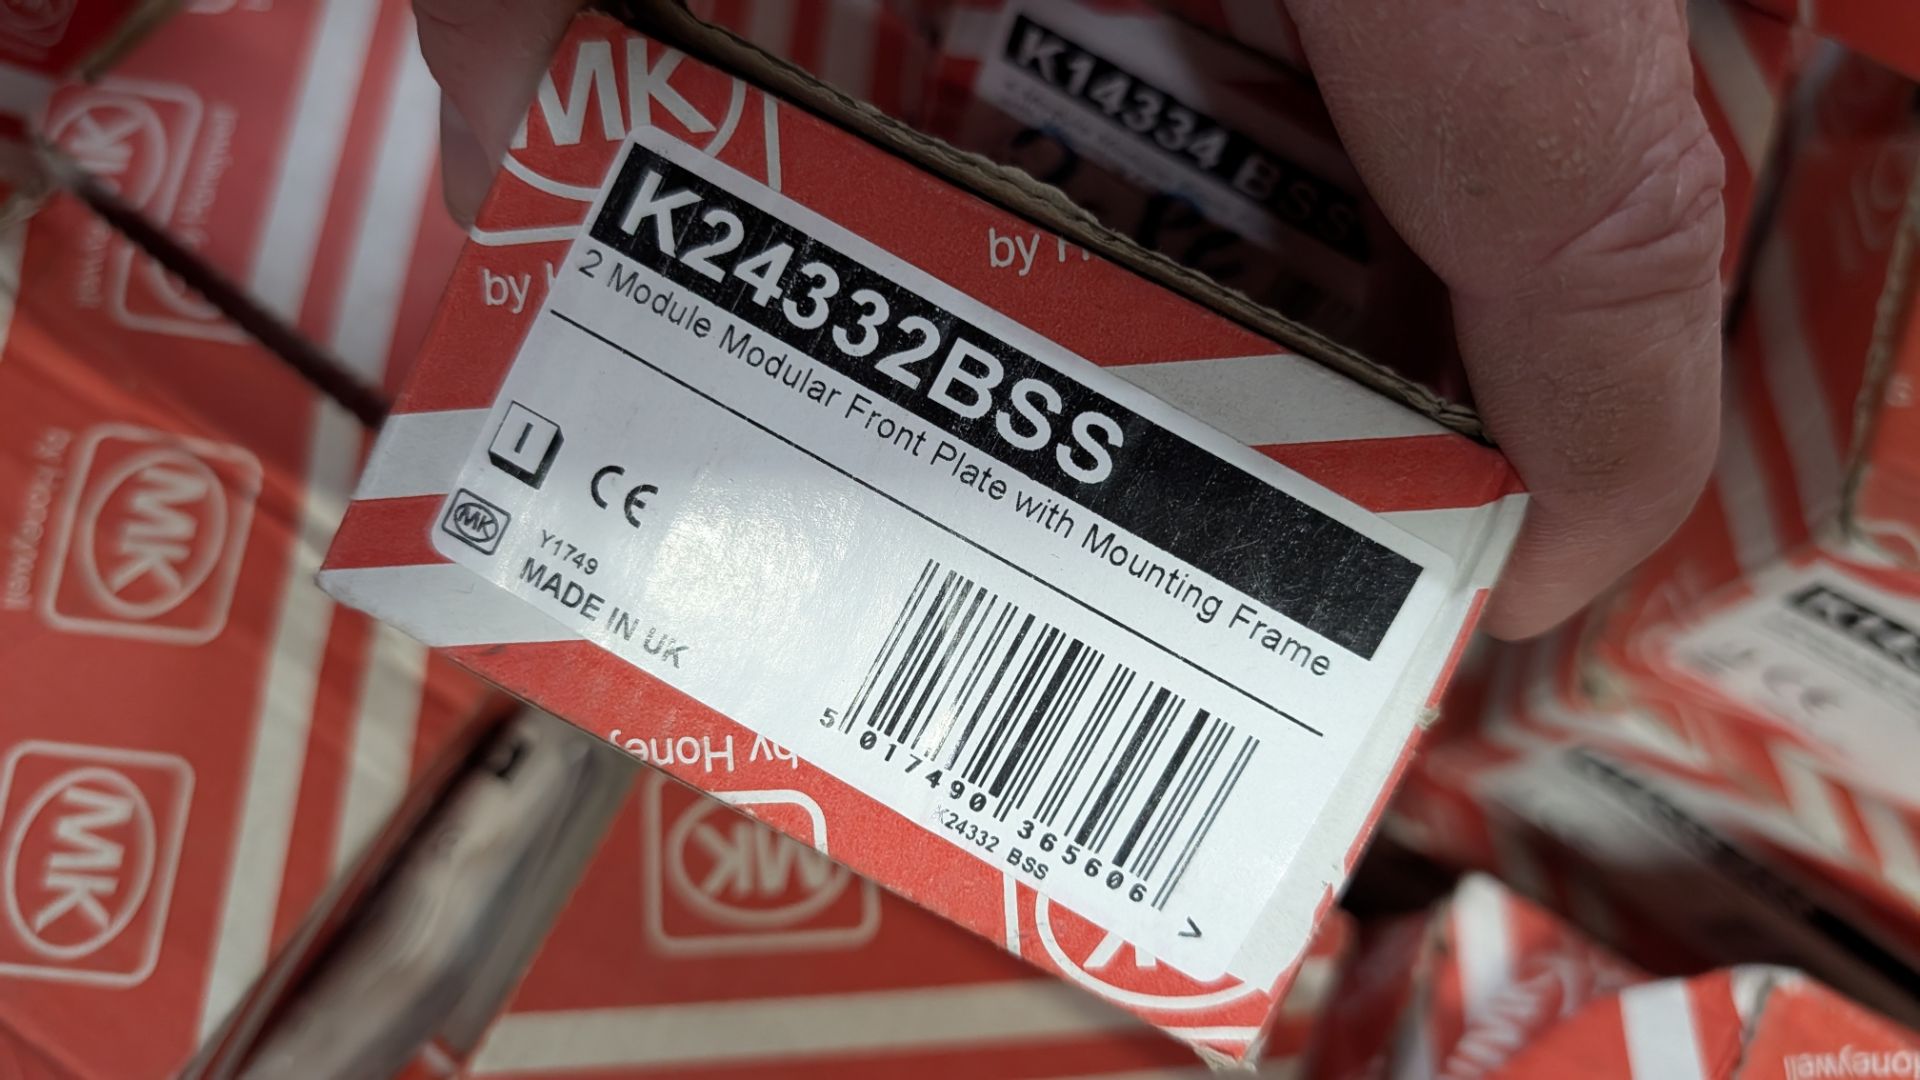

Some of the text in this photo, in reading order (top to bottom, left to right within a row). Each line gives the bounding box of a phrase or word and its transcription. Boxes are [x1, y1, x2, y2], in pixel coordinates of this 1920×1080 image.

[510, 38, 717, 150] MK
[1017, 28, 1230, 169] K14334
[482, 269, 531, 314] by
[989, 228, 1040, 277] by
[620, 169, 1124, 484] K24332BSS
[578, 249, 603, 279] 2
[606, 262, 712, 339] Module
[718, 325, 842, 407] Modular
[845, 392, 931, 457] Front
[929, 440, 1008, 501] Plate
[1015, 489, 1078, 538] with
[1081, 523, 1224, 624] Mounting
[1227, 603, 1331, 677] Frame
[590, 464, 660, 529] CE
[111, 467, 211, 592] MK
[458, 504, 495, 539] MK
[540, 529, 599, 576] Y1749
[520, 557, 690, 669] MADE IN UK
[818, 707, 839, 729] 5
[34, 785, 138, 933] MK
[694, 820, 832, 899] MK
[1006, 847, 1049, 881] BSS
